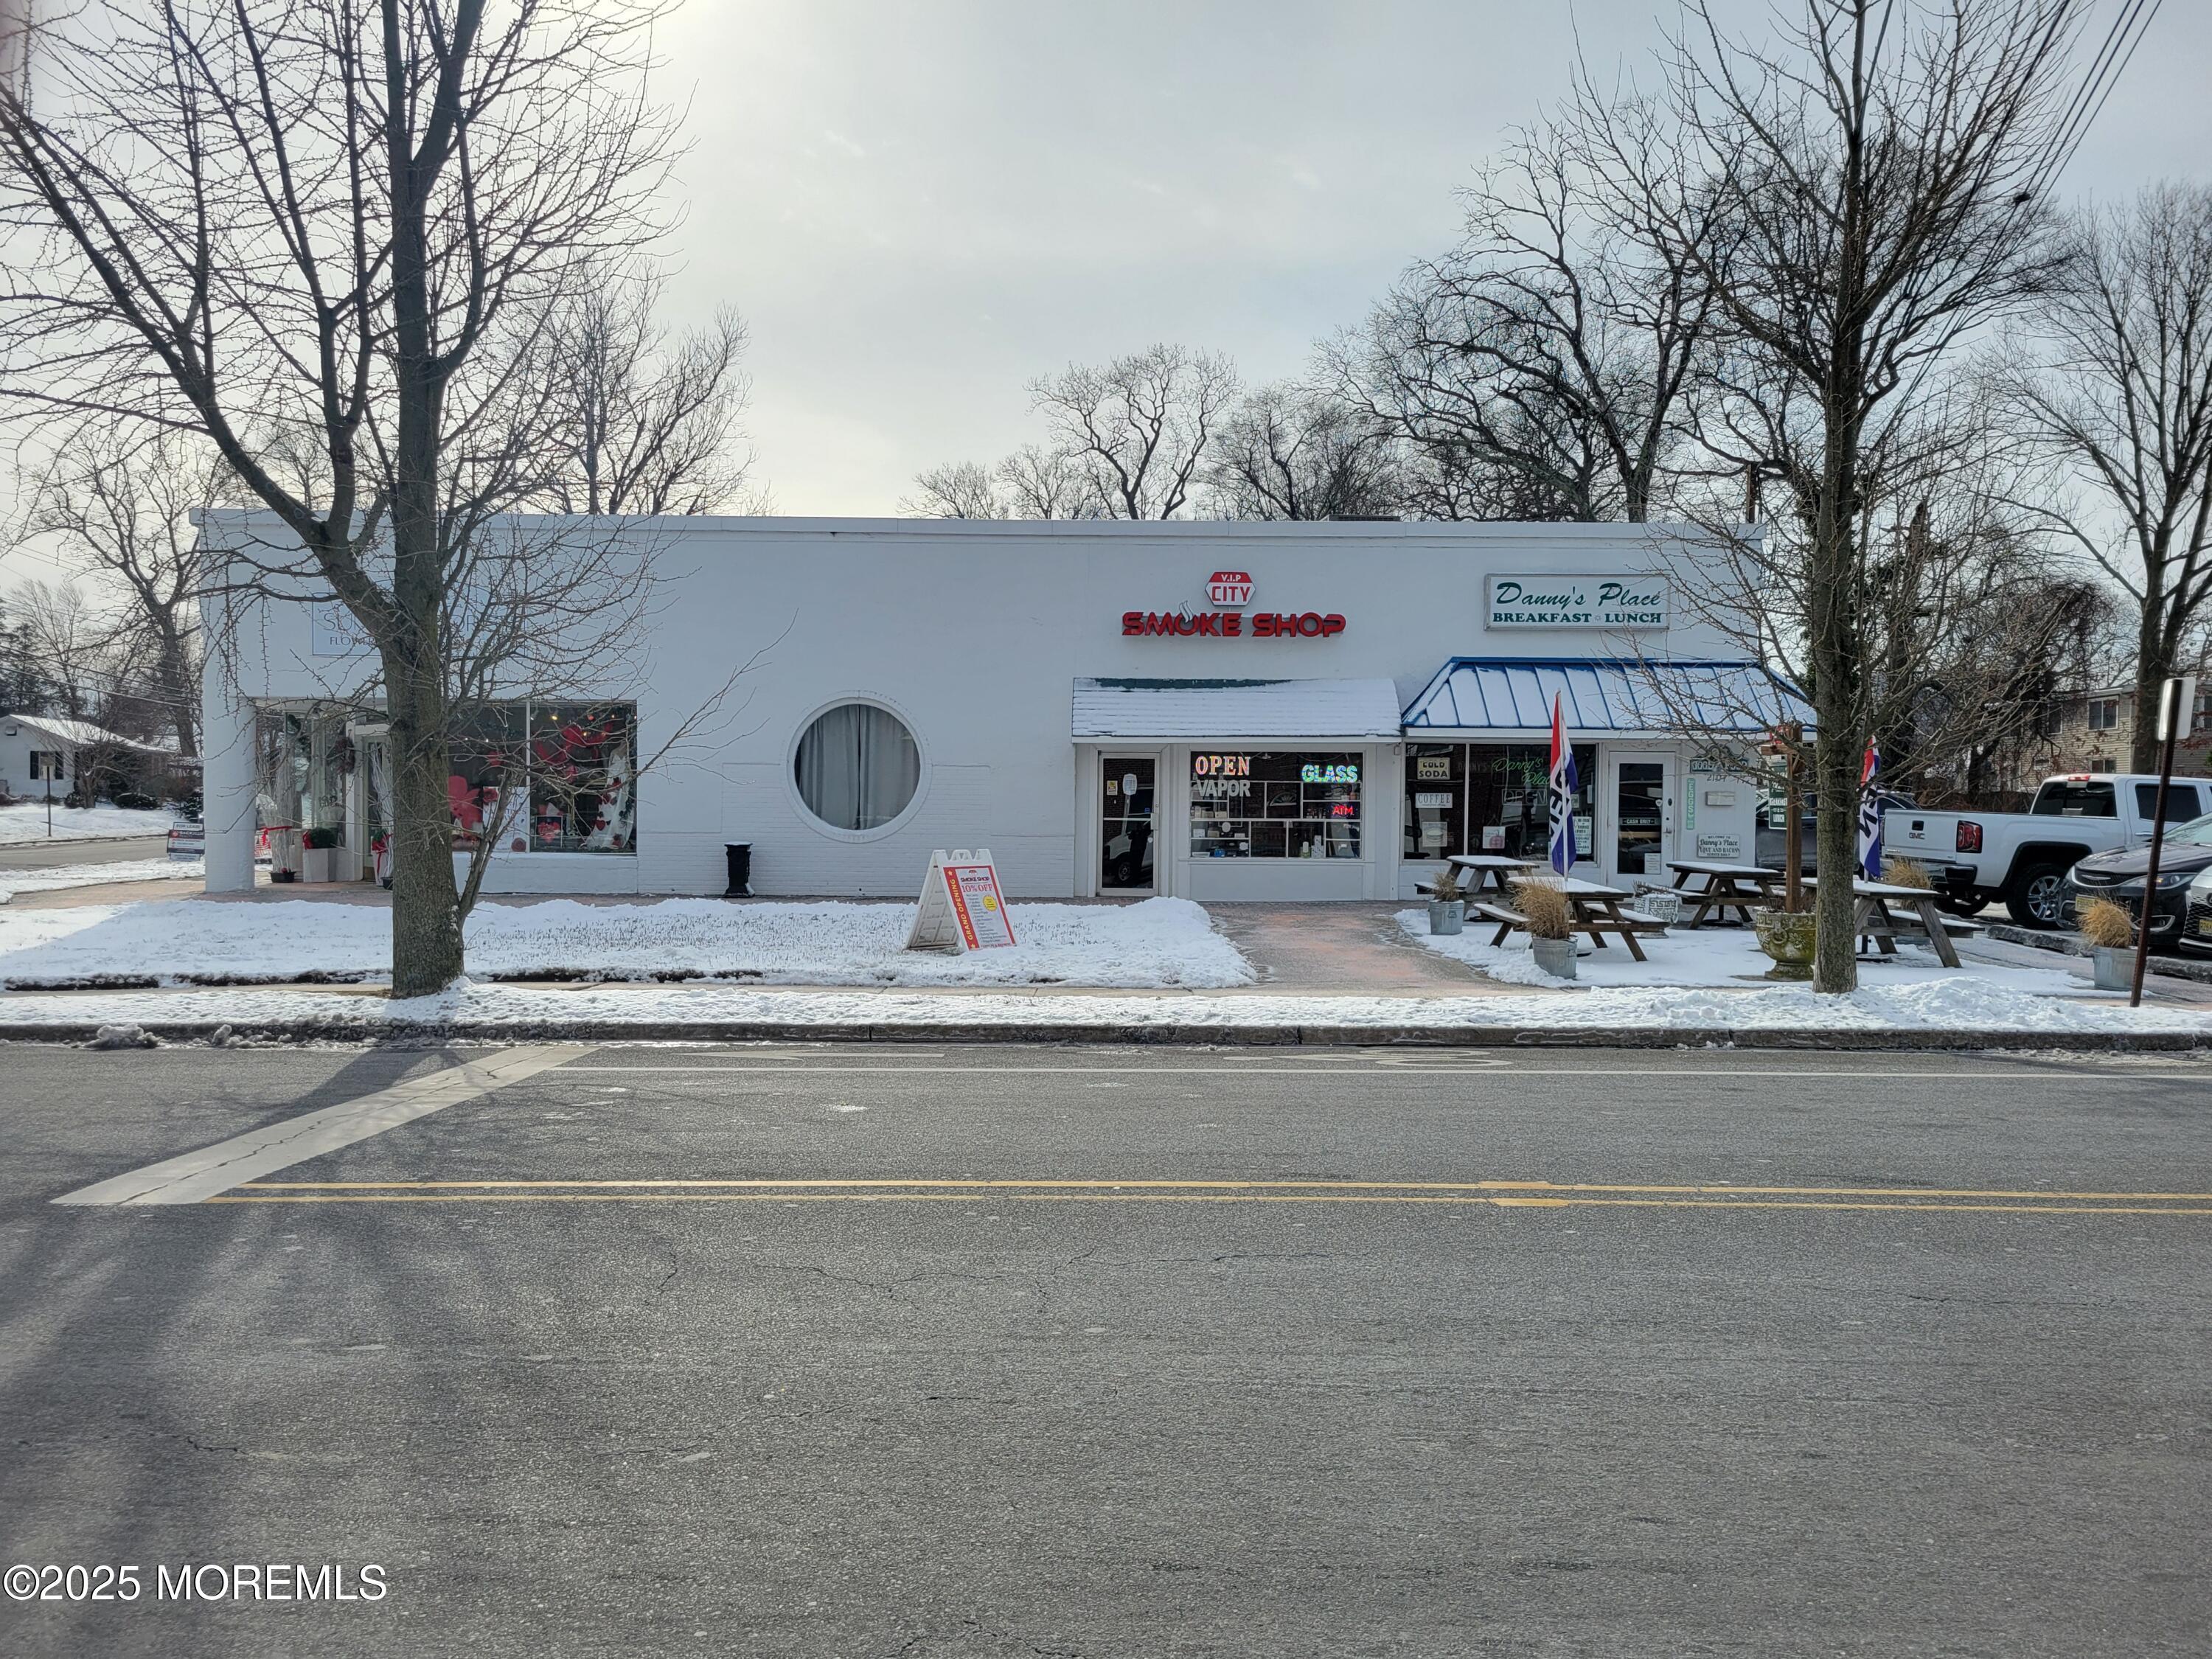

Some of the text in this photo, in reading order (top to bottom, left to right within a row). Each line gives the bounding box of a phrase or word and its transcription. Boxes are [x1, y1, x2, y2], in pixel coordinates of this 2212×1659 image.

[1221, 574, 1242, 582] V.I.P
[1211, 586, 1251, 602] CITY
[1496, 582, 1661, 611] Danny's Place
[1122, 611, 1346, 637] SMOKE SHOP
[1492, 612, 1662, 623] BREAKFAST LUNCH
[1195, 756, 1251, 776] OPEN
[1492, 758, 1543, 772] Danny's
[1301, 765, 1357, 782] GLASS
[1197, 779, 1251, 797] VAPOR
[1418, 794, 1450, 804] COFFEE
[1333, 805, 1354, 815] ATM
[1700, 839, 1722, 847] Danny's
[961, 883, 992, 892] 10% OFF
[950, 879, 973, 940] GRAND OPENING
